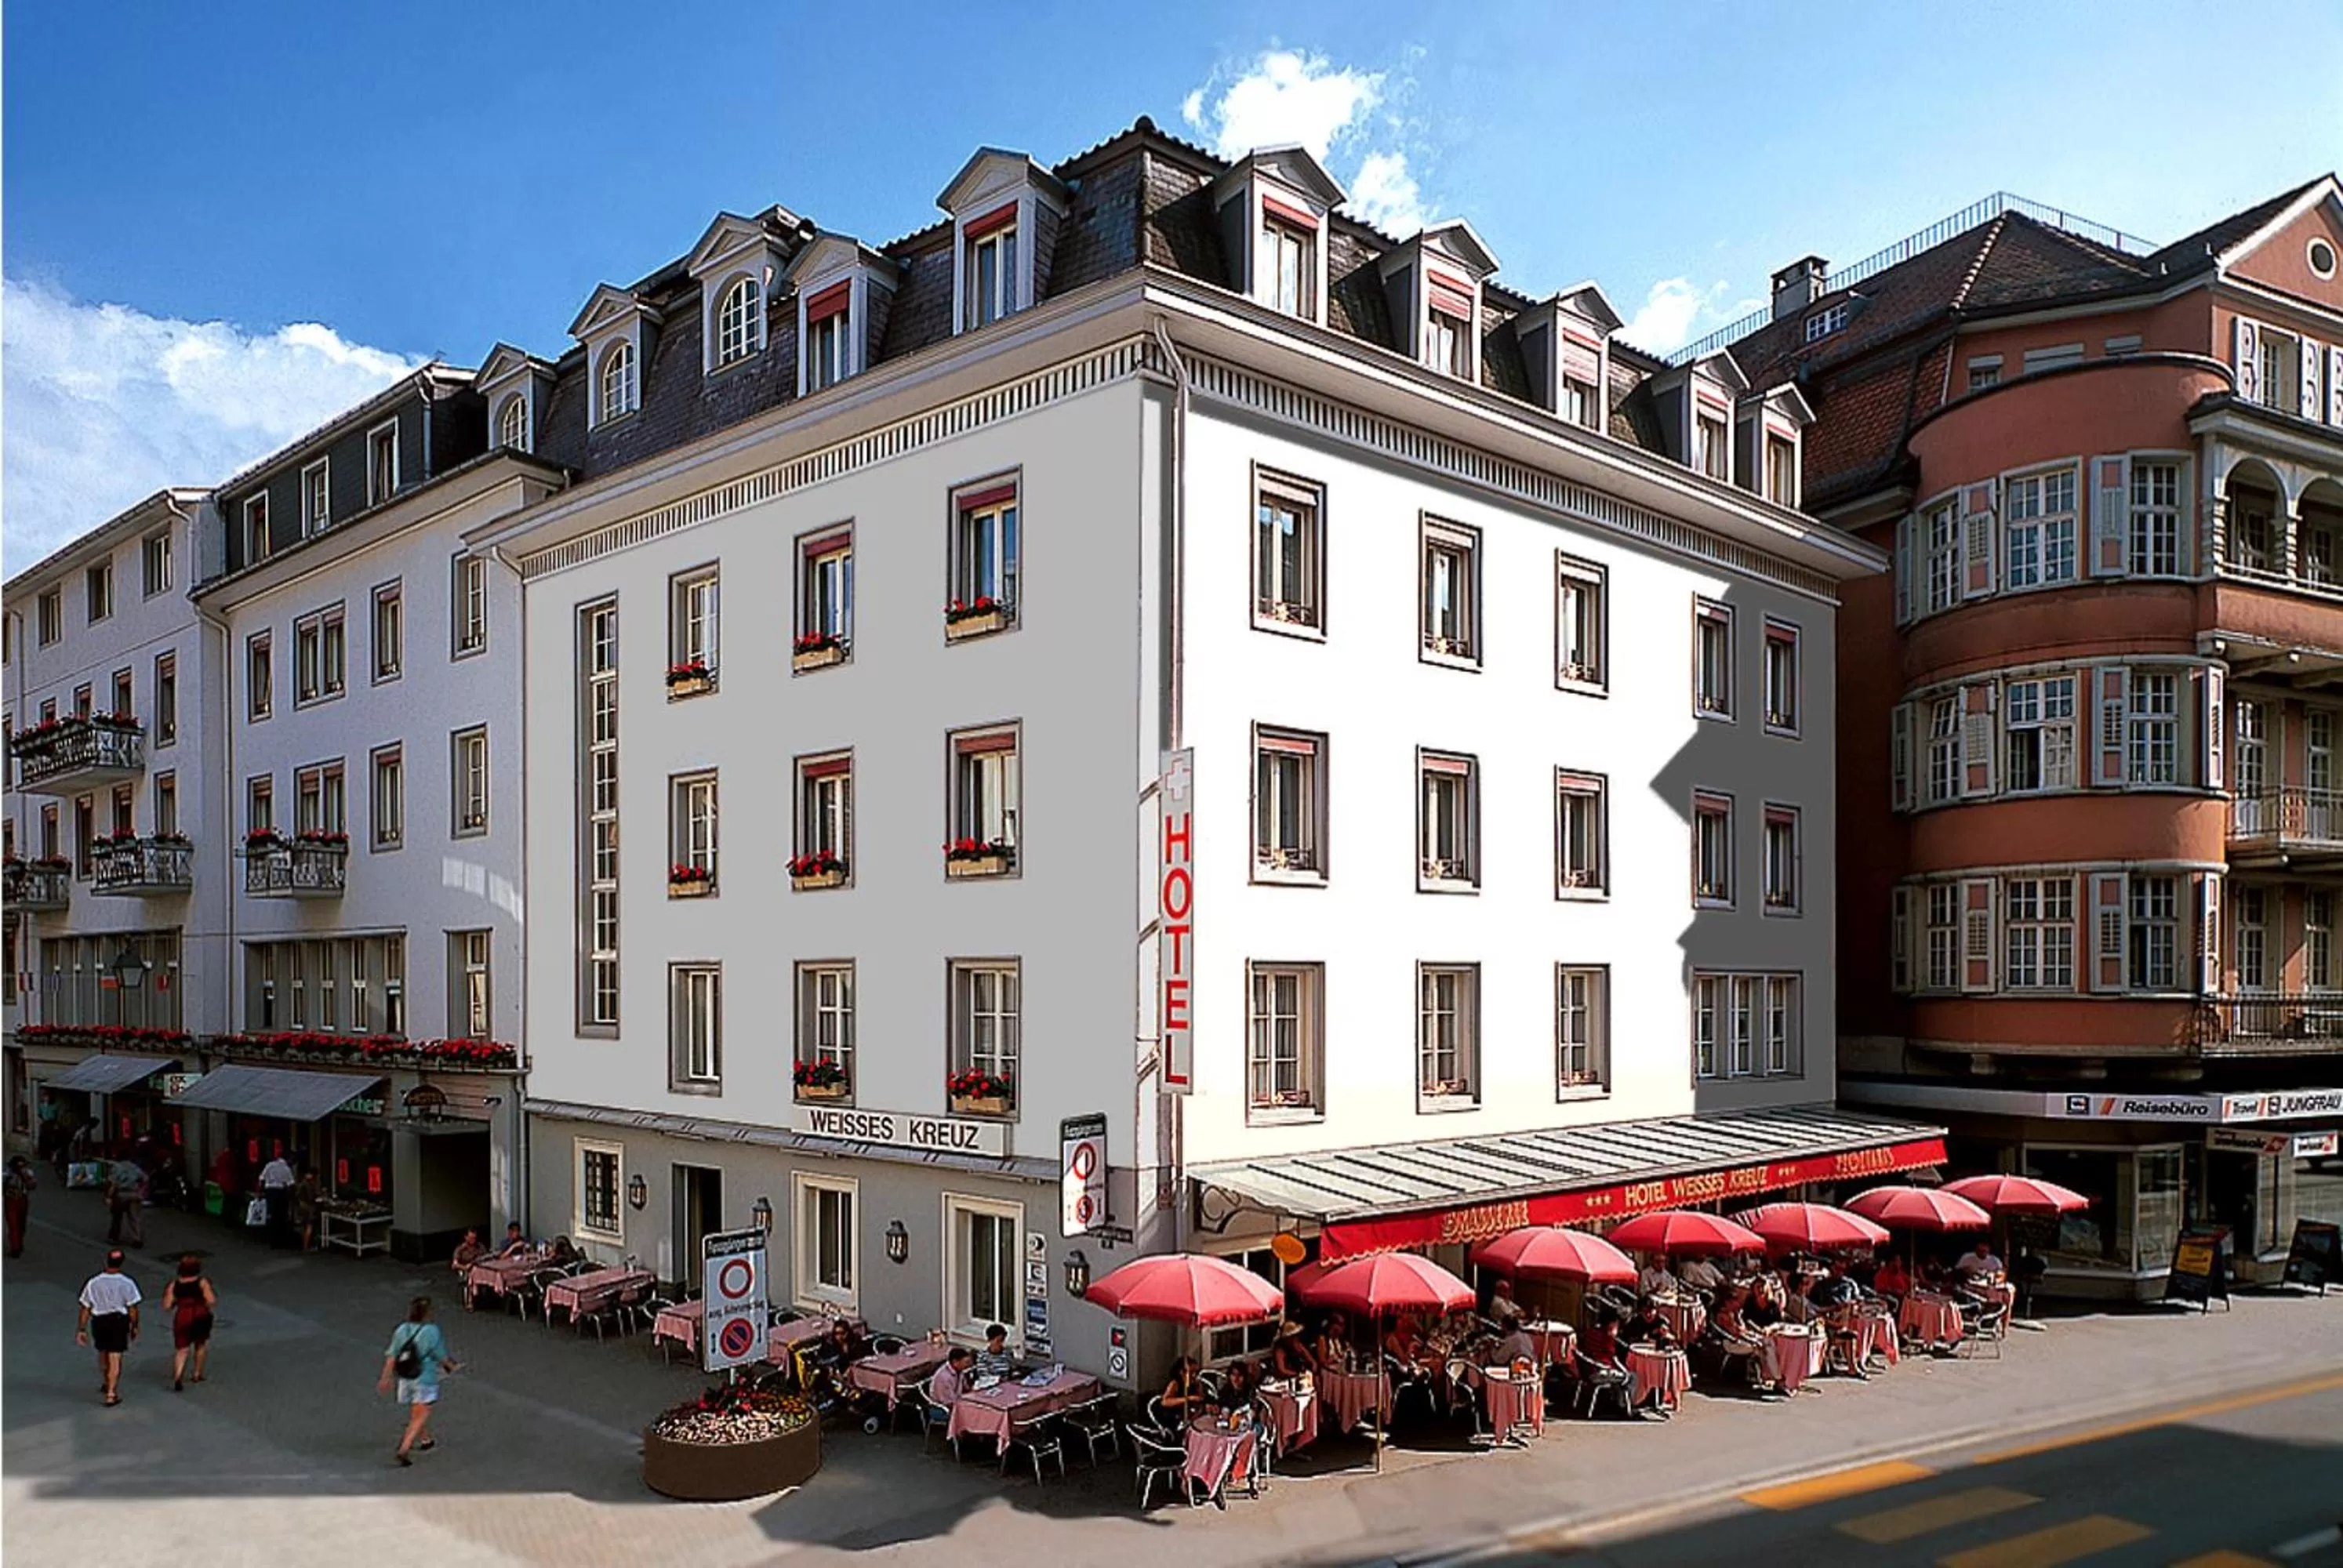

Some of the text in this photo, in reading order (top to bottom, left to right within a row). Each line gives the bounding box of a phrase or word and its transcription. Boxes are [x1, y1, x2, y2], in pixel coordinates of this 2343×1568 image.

[1164, 811, 1192, 1085] HOTEL
[2122, 1100, 2209, 1116] Reisebüro
[2283, 1094, 2342, 1112] JUNGFRAU
[809, 1109, 980, 1149] WEISSES KREUZ
[1625, 1181, 1668, 1207] HOTEL
[1672, 1173, 1726, 1199] WEISSES
[1729, 1166, 1768, 1188] KREUZ
